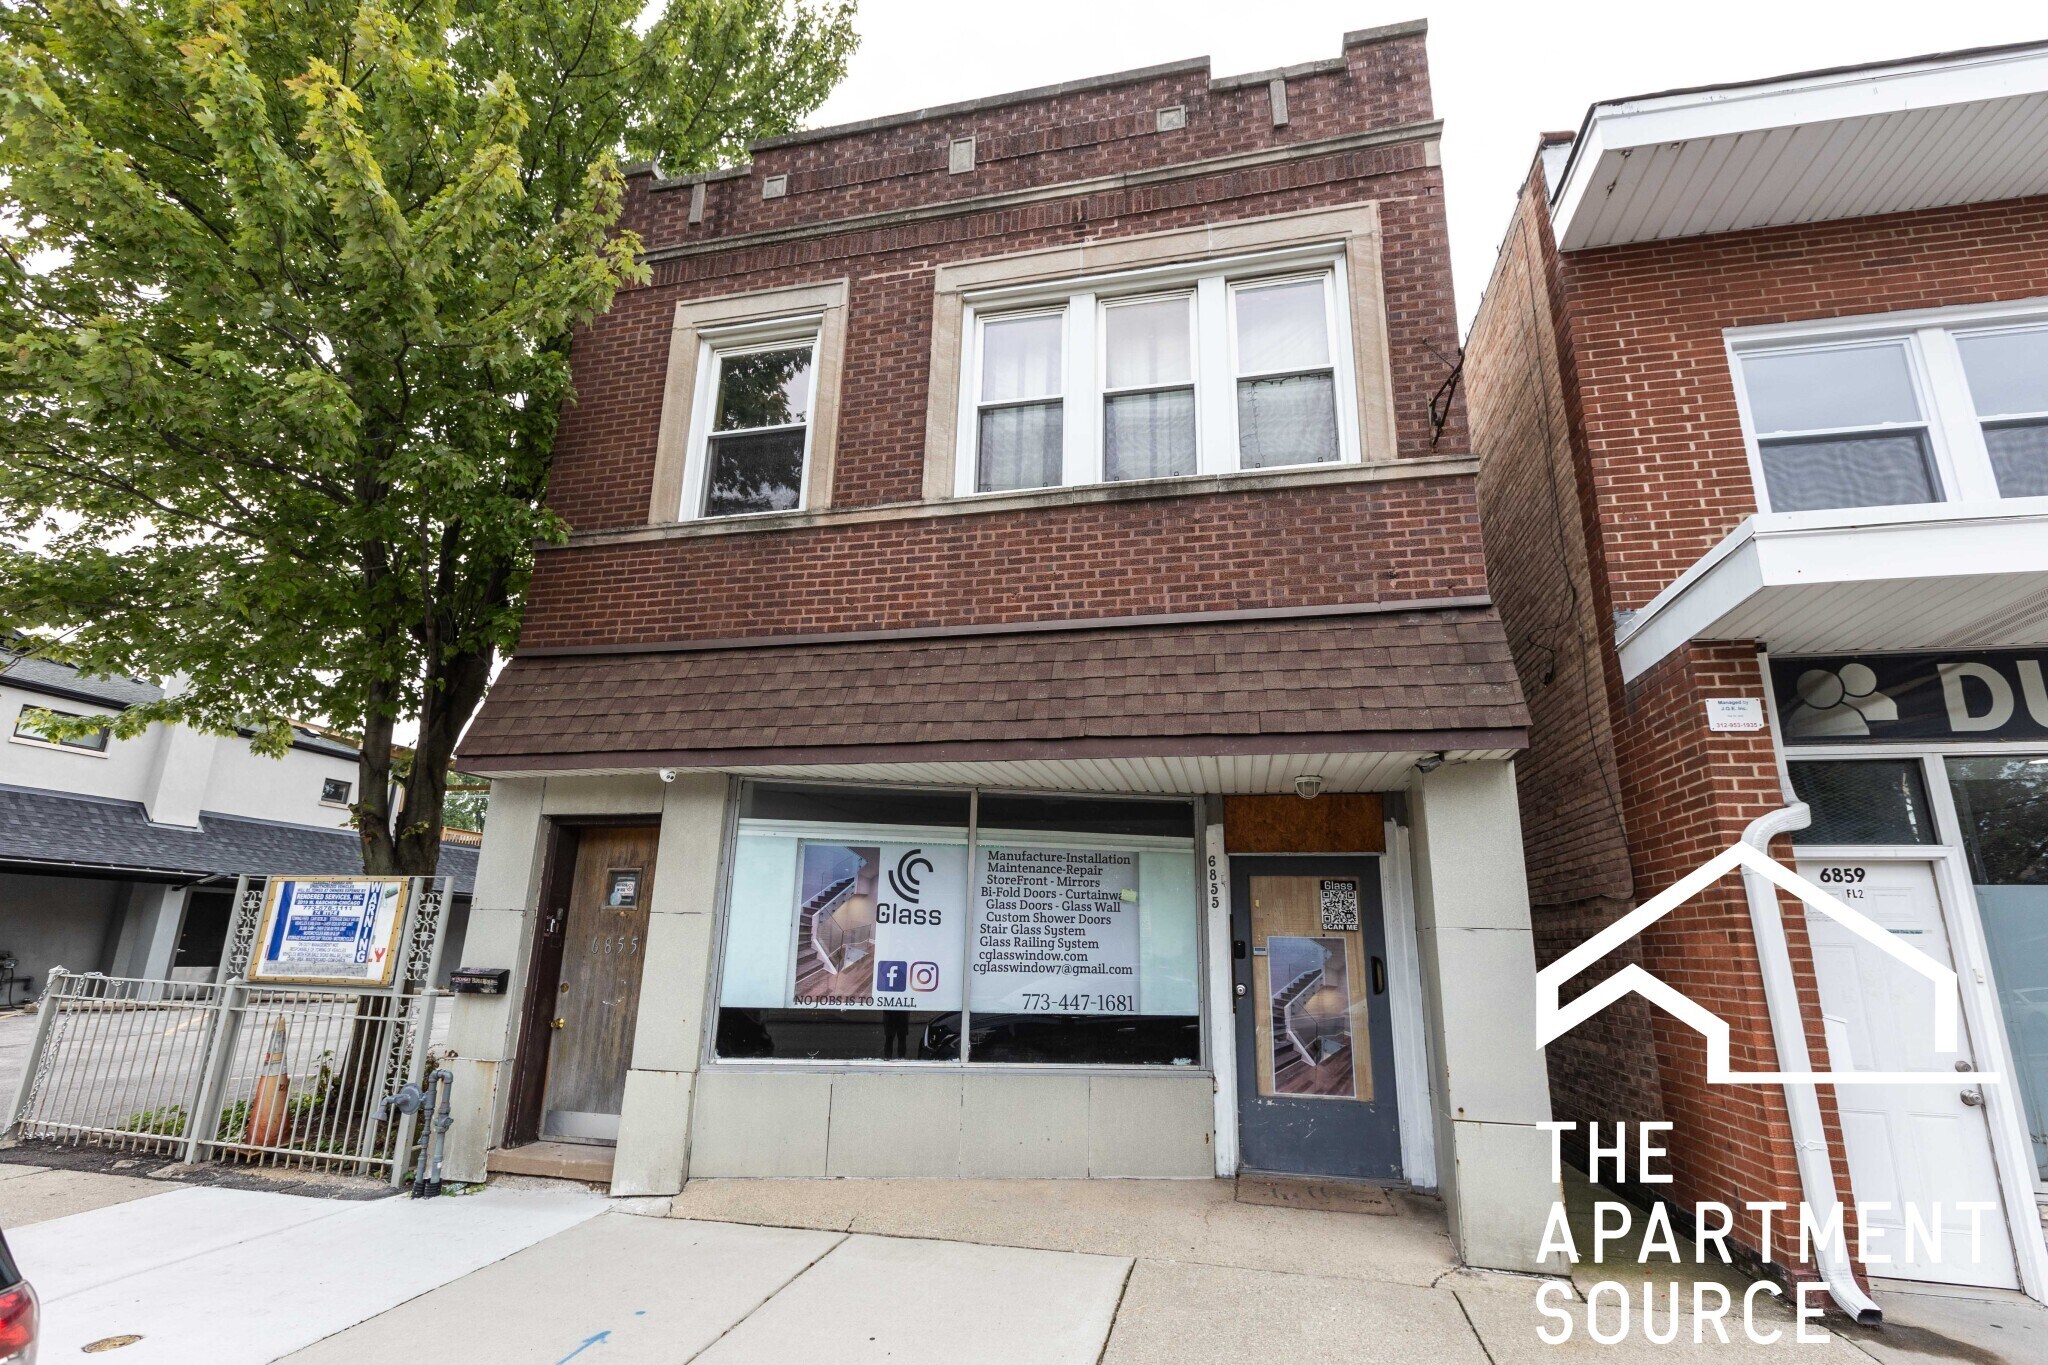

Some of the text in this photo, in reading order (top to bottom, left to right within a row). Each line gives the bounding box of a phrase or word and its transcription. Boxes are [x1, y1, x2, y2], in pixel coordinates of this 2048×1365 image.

[987, 850, 1131, 865] Manufacture-Installation
[987, 862, 1104, 877] Maintenance-Repair
[1820, 867, 1866, 883] 6859
[986, 874, 1048, 886] StoreFront
[1056, 876, 1101, 888] Mirrors
[1208, 855, 1220, 909] 6855
[1324, 880, 1353, 890] Glass
[980, 886, 1021, 898] Bi-Fold
[1023, 887, 1057, 898] Doors
[986, 899, 1017, 910] Glass
[1019, 900, 1053, 911] Doors
[1061, 900, 1092, 912] Glass
[1094, 901, 1121, 913] Wall
[875, 903, 942, 925] Glass
[986, 911, 1112, 925] Custom Shower Doors
[357, 881, 382, 963] WARNING
[979, 924, 1086, 938] Stair Glass System
[592, 936, 639, 955] 6855
[979, 936, 1099, 951] Glass Railing System
[979, 949, 1089, 962] cglasswindow.com
[973, 961, 1133, 977] cglasswindow7@gmail.com
[794, 995, 917, 1009] NO JOBS IS TO SMALL
[1022, 993, 1135, 1012] 773-447-1681
